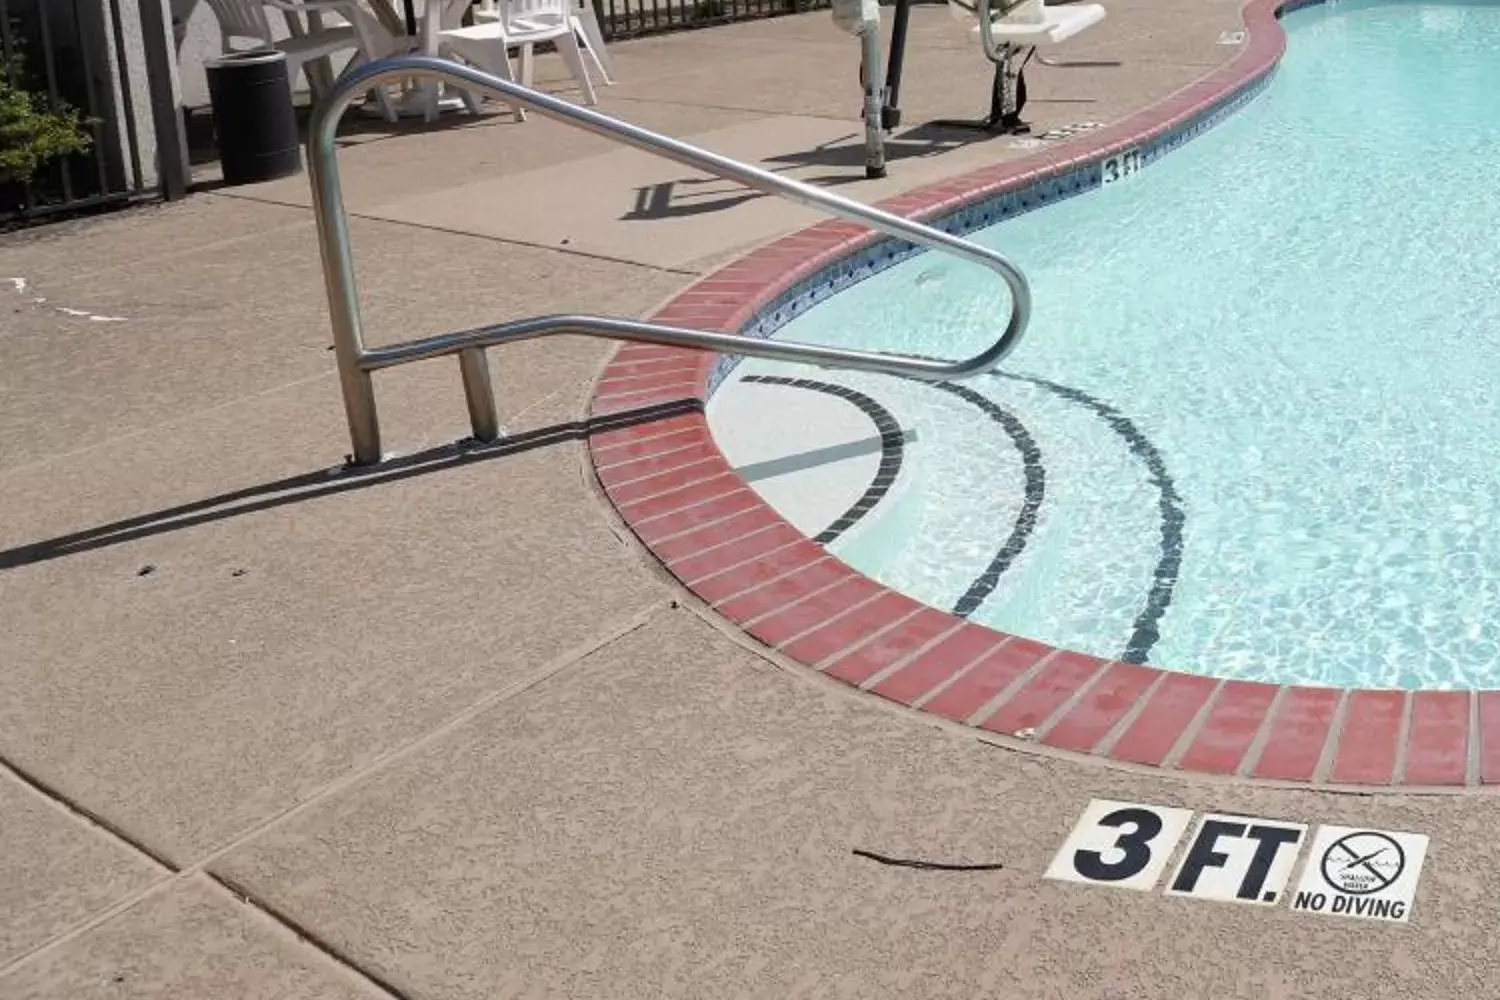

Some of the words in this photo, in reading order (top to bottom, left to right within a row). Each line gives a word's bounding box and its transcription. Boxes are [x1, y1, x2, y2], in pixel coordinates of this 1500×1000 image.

[1105, 158, 1120, 183] 3
[1074, 807, 1162, 881] 3
[1171, 820, 1301, 901] FT.
[1294, 890, 1326, 911] NO
[1331, 894, 1406, 919] DIVING
